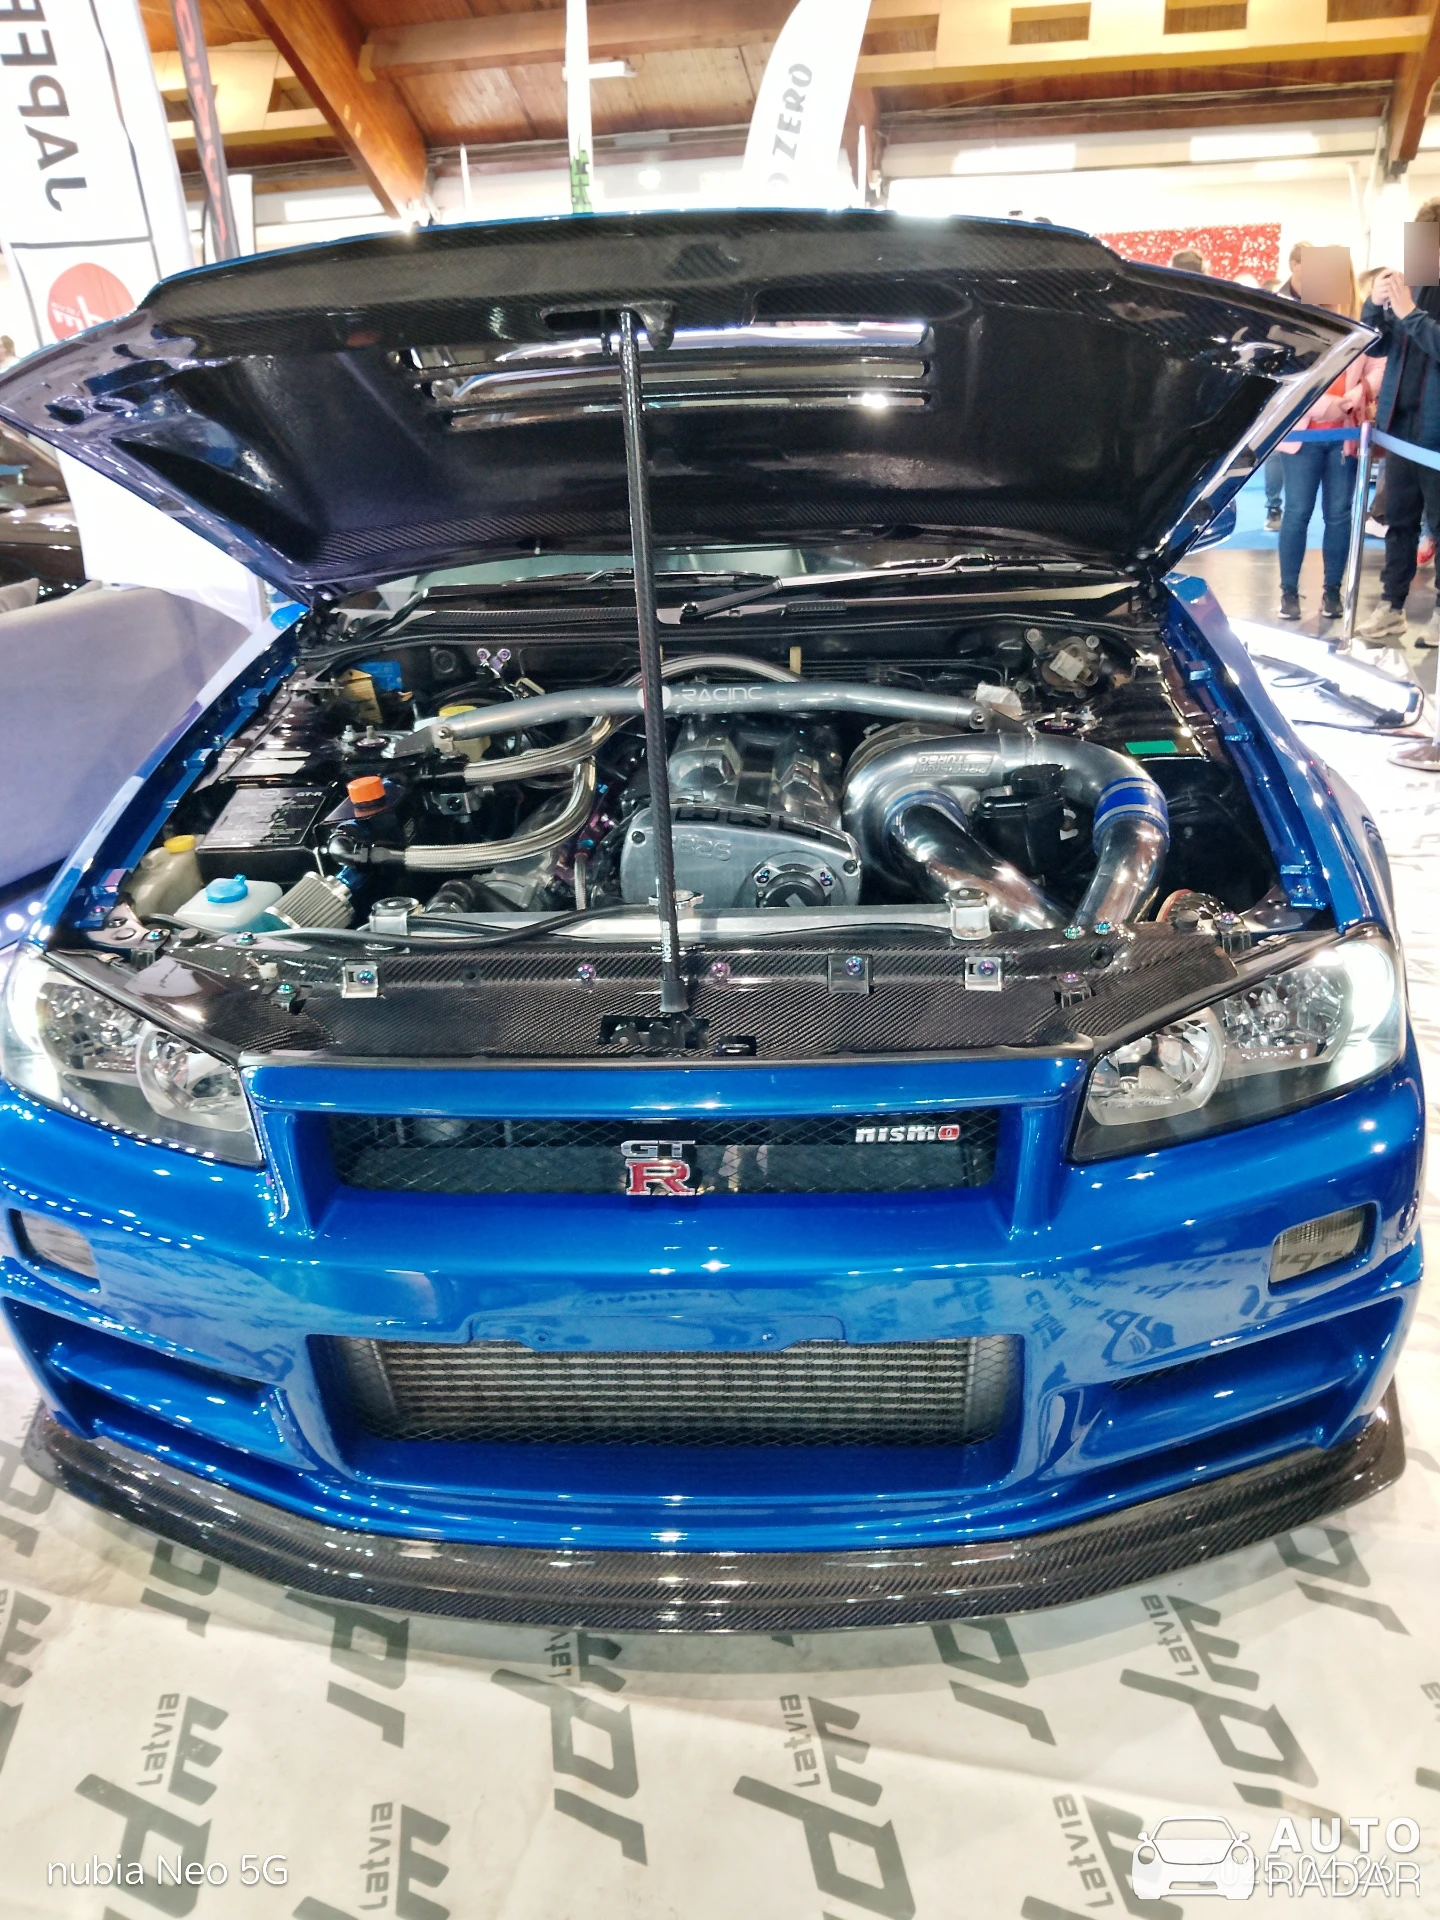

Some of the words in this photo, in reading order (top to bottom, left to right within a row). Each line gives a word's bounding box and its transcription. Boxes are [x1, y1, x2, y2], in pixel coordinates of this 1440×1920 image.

[771, 63, 813, 161] ZERO
[918, 754, 964, 764] TURBO
[674, 834, 732, 862] B26
[855, 1119, 960, 1143] nismo
[620, 1140, 696, 1157] GT
[625, 1158, 696, 1196] R
[75, 1695, 229, 1920] dm
[733, 1696, 917, 1920] dm
